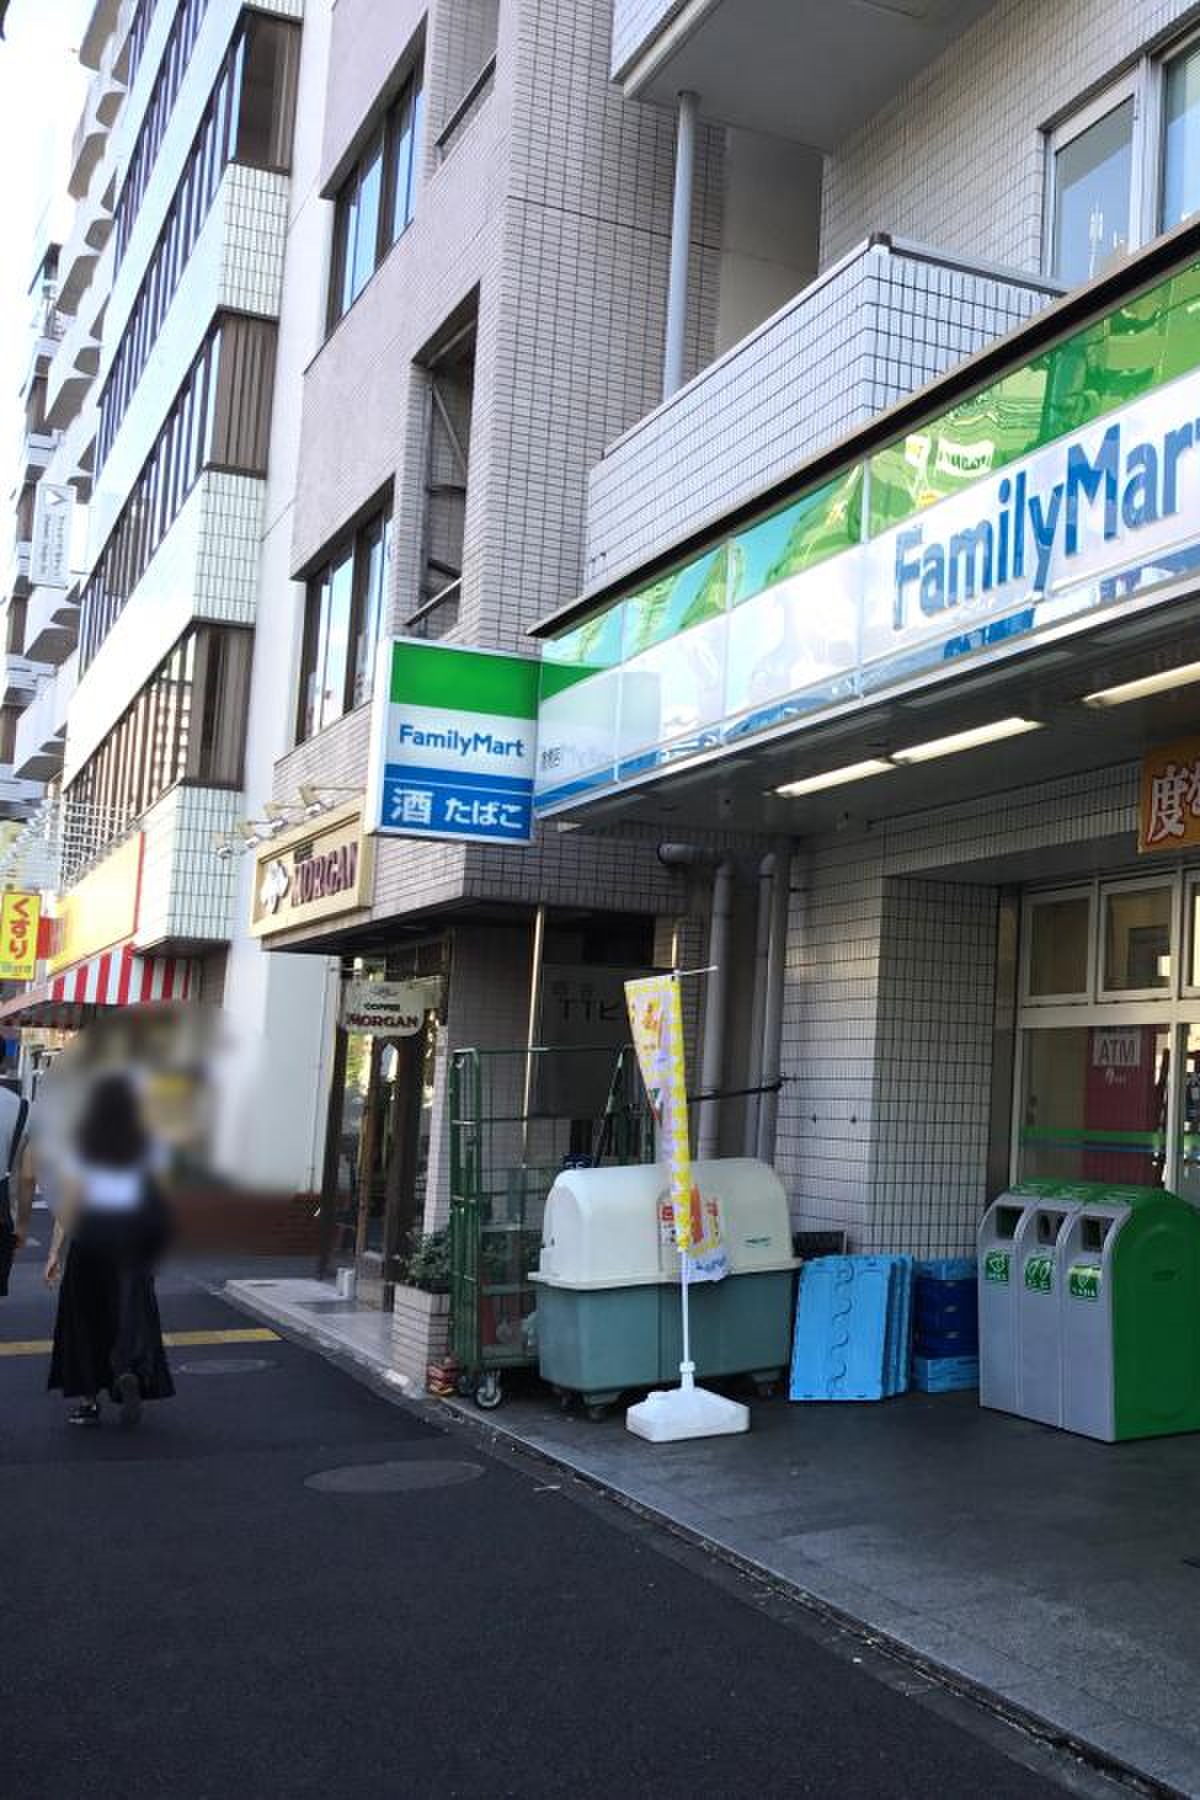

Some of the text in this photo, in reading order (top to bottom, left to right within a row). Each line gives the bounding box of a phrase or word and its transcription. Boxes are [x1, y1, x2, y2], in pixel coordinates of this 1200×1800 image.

[399, 723, 525, 757] FamilyMart
[391, 787, 523, 830] 酒 たばこ
[9, 897, 31, 960] くすり
[1098, 1040, 1136, 1063] ATM
